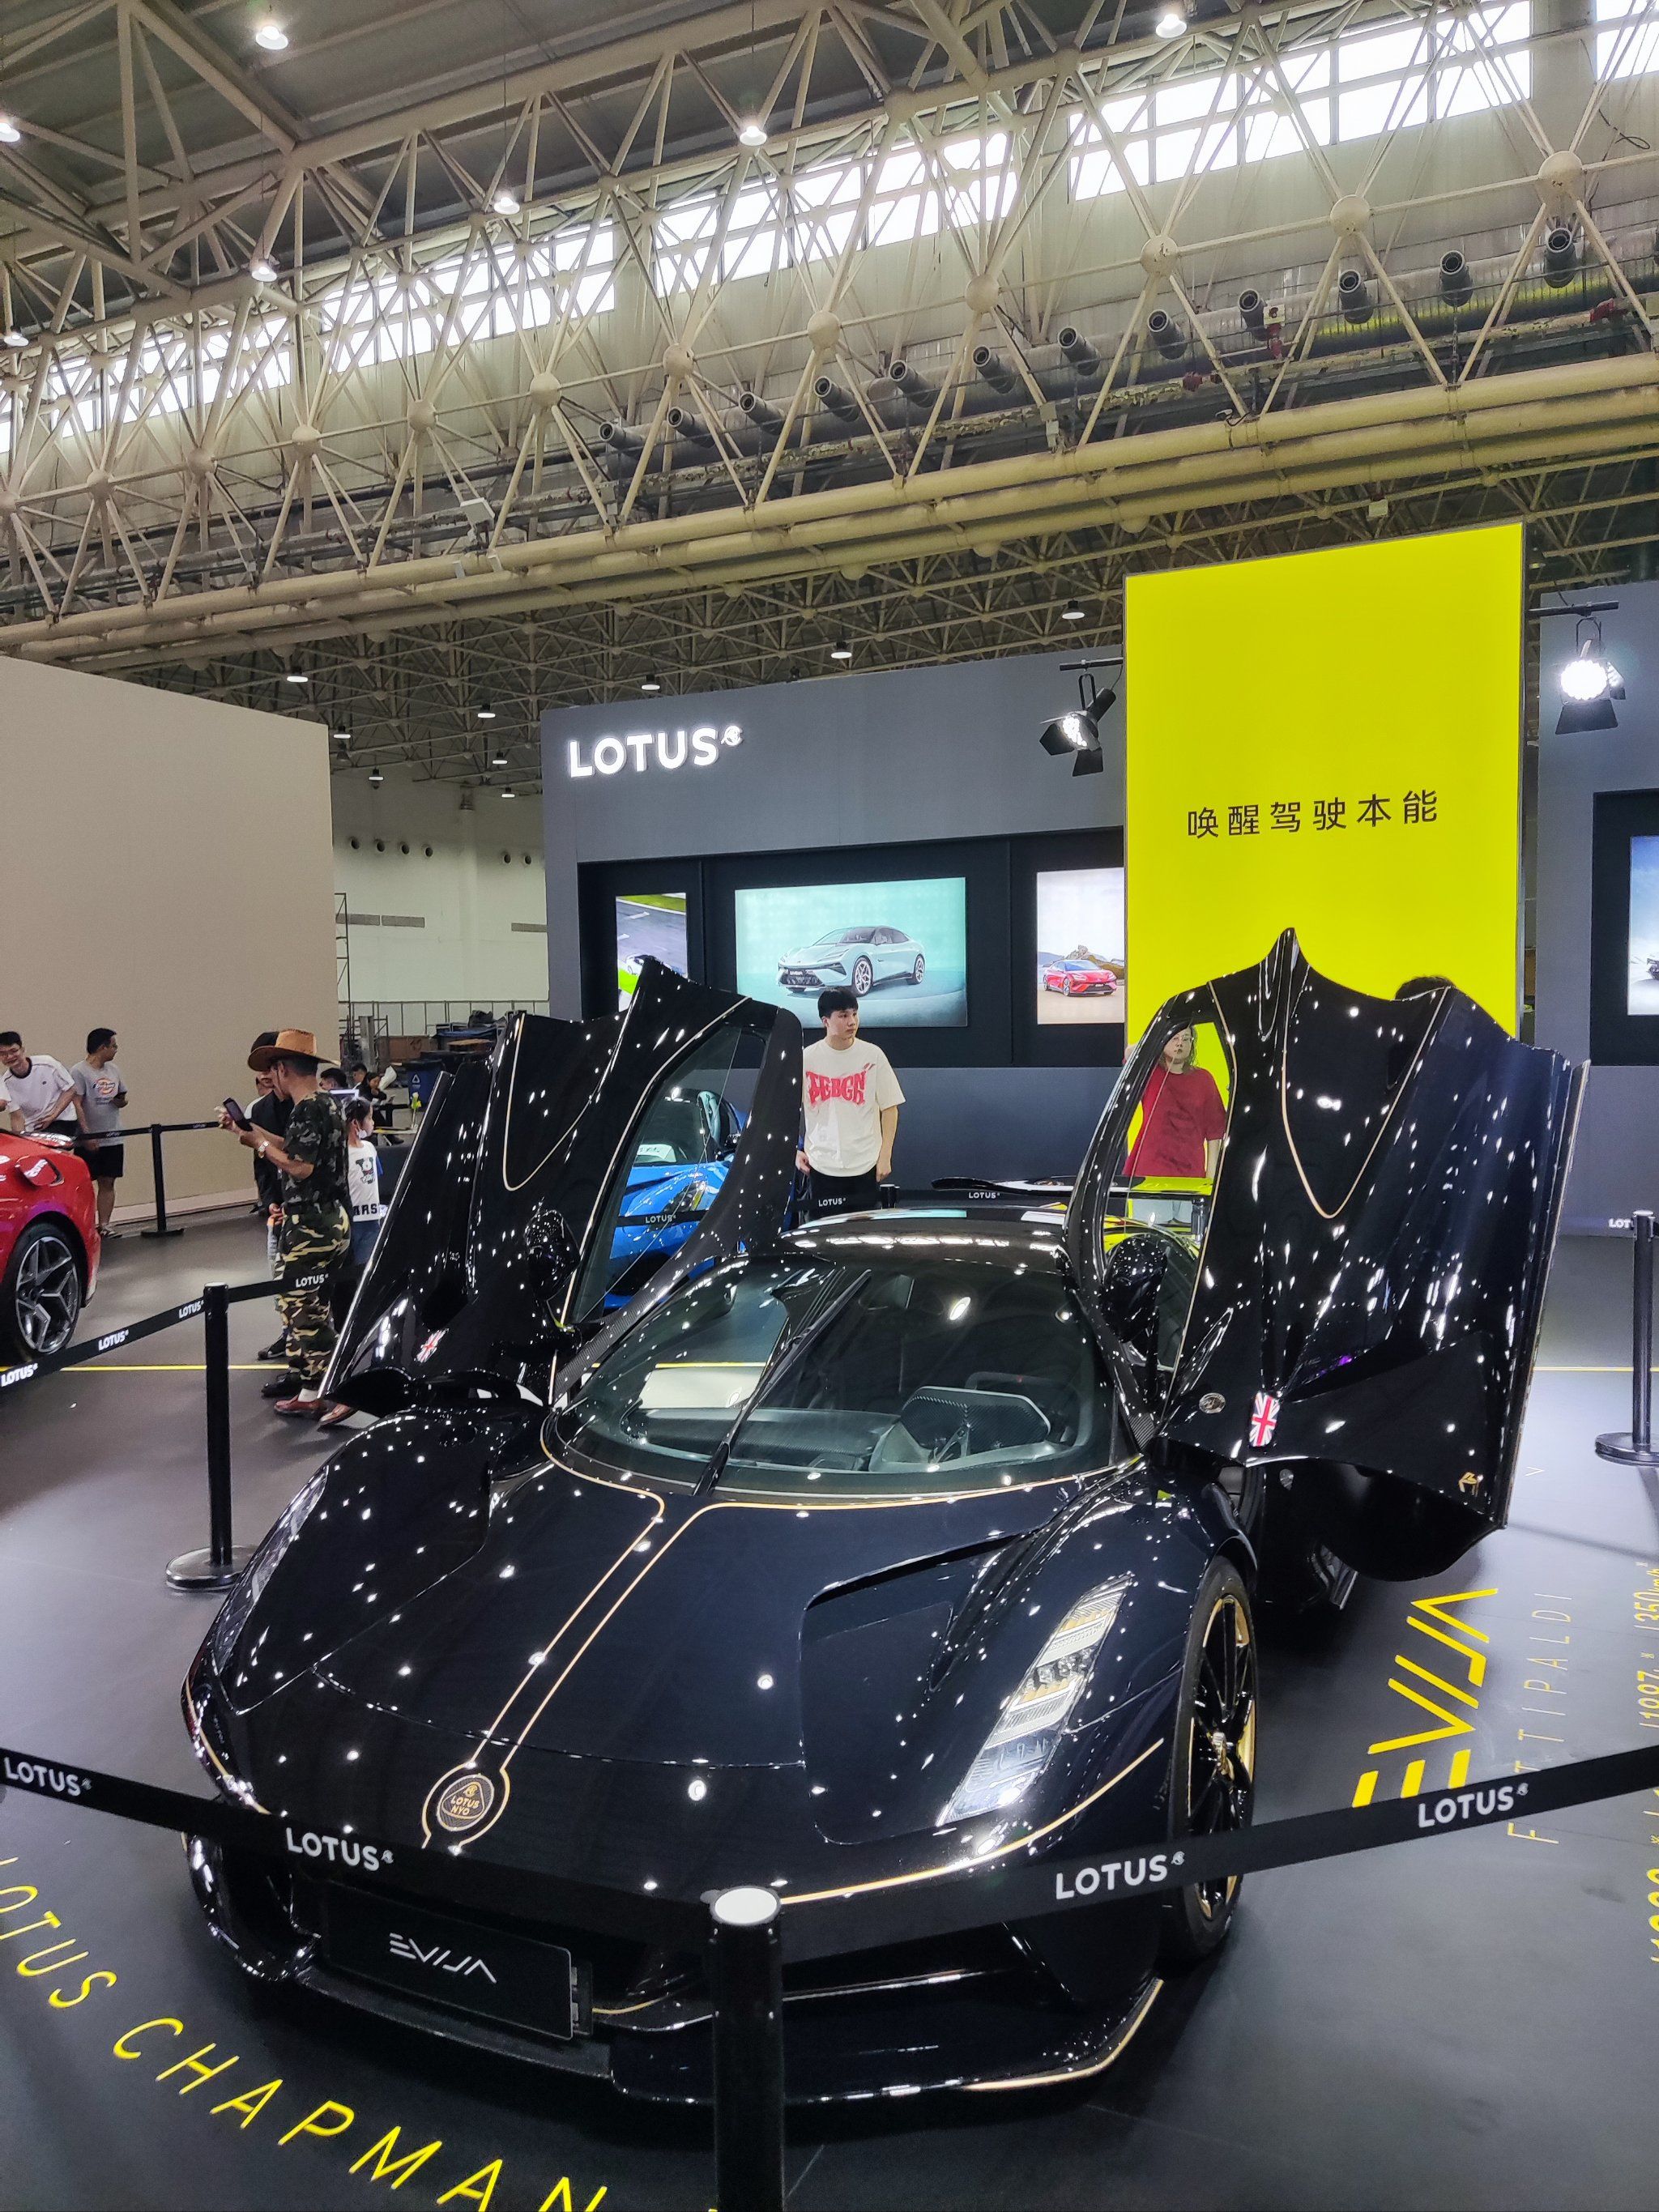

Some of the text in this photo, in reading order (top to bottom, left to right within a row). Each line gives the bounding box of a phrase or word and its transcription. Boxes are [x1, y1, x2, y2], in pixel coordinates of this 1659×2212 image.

[569, 727, 719, 778] LOTUS
[1187, 789, 1438, 839] 唤醒驾驶本能
[818, 1197, 843, 1208] LOTUS
[968, 1191, 996, 1200] LOTUS
[645, 1215, 673, 1224] LOTUS
[295, 1273, 325, 1288] LOTUS
[178, 1300, 201, 1319] LOTUS
[98, 1330, 126, 1351] LOTUS
[1, 1364, 34, 1387] LOTUS
[1507, 1592, 1572, 1844] FTTIPALDI
[3, 1756, 81, 1796] LOTUS
[450, 1796, 480, 1809] LOTUS
[1418, 1785, 1515, 1828] LOTUS
[285, 1827, 380, 1872] LOTUS
[1056, 1854, 1168, 1900] LOTUS
[0, 1856, 117, 2009] OTUS
[389, 1932, 497, 1984] EVIJA
